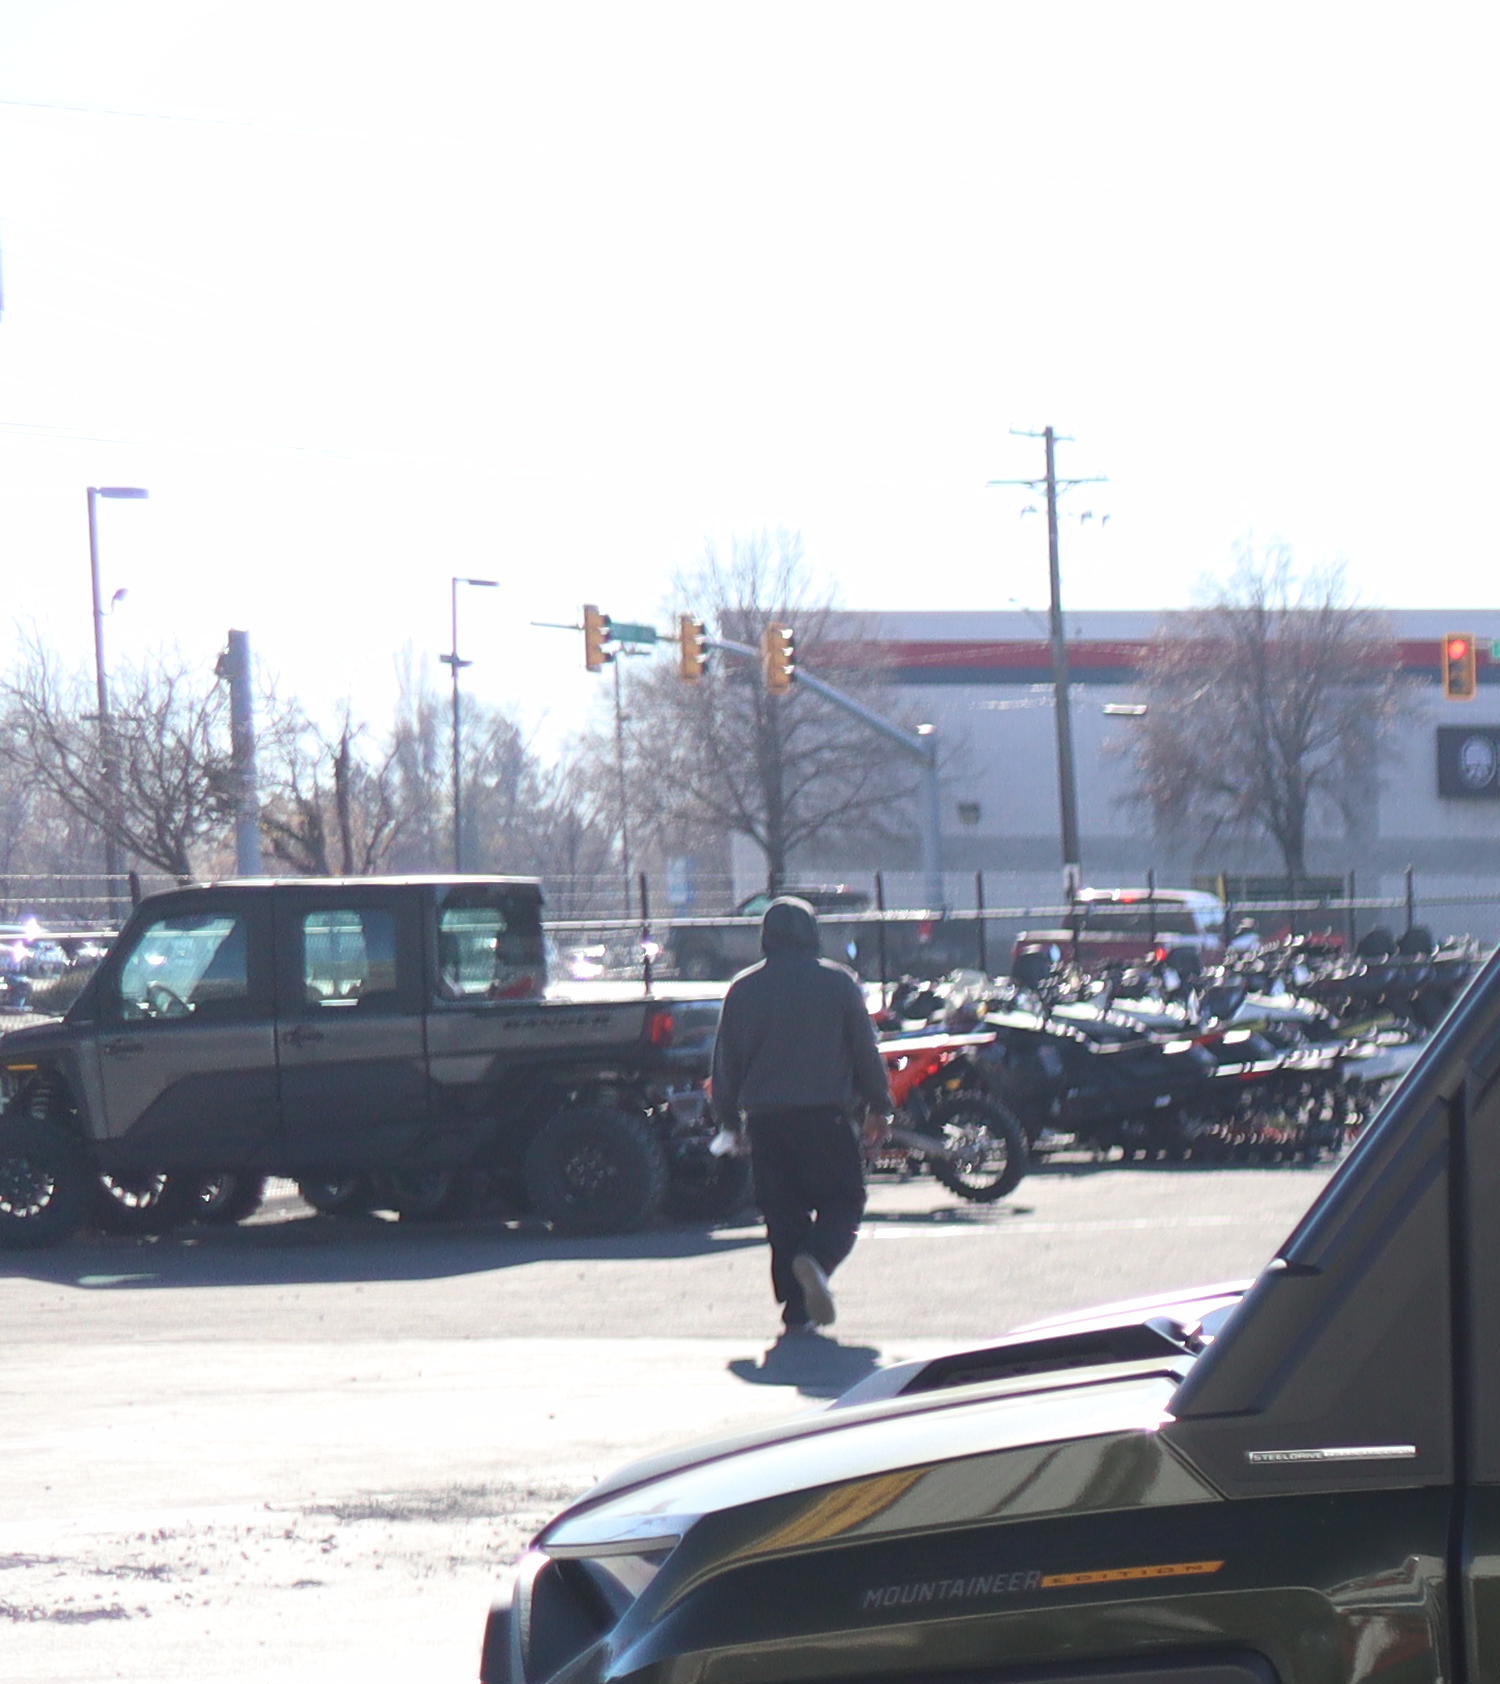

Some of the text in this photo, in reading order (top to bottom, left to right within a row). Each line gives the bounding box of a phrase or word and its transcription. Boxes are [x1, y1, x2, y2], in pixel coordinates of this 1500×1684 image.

[1252, 1451, 1324, 1462] STEELDRIVE
[862, 1562, 1205, 1609] MOUNTAINEER EDITION
